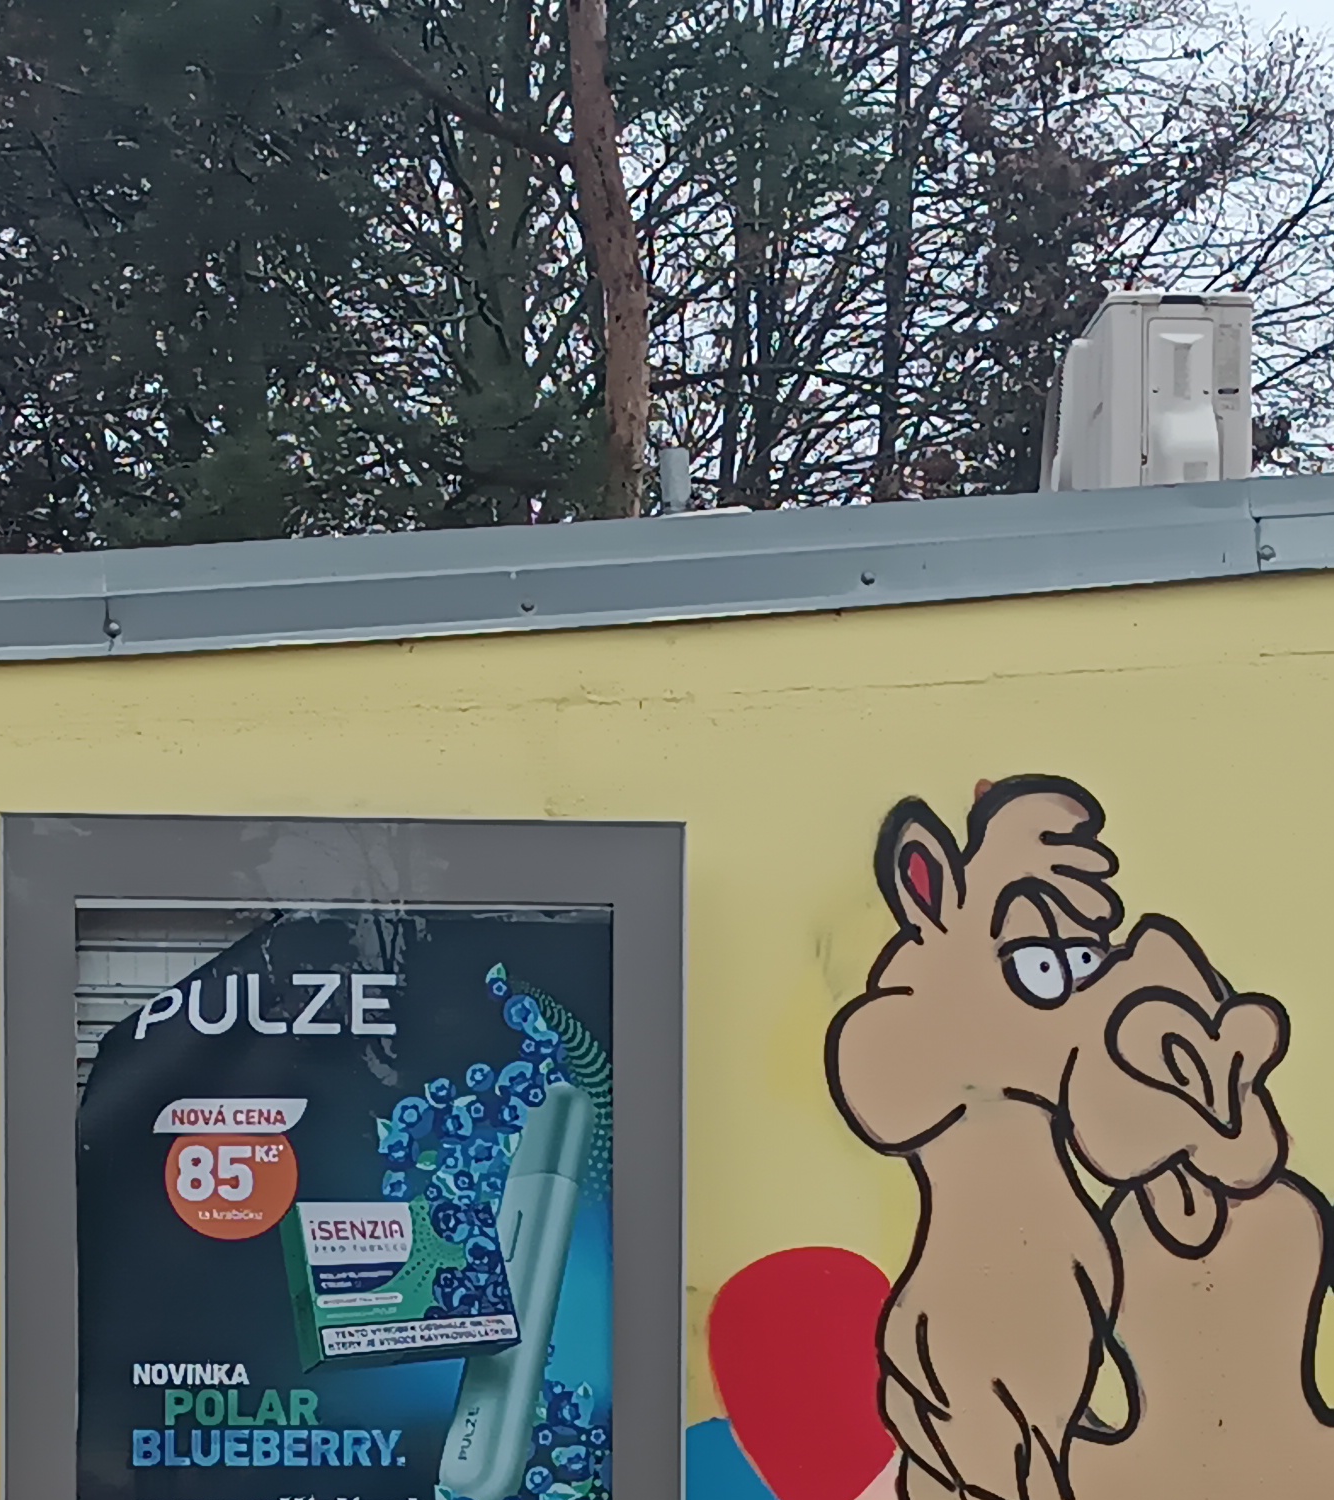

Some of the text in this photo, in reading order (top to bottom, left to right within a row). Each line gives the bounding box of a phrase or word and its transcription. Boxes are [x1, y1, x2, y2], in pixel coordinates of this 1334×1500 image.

[134, 973, 397, 1040] PULZE
[172, 1105, 287, 1126] NOVÁ CENA
[177, 1145, 253, 1201] 85
[133, 1363, 250, 1385] NOVINKA
[165, 1389, 319, 1426] POLAR
[132, 1429, 406, 1467] BLUEBERRY.
